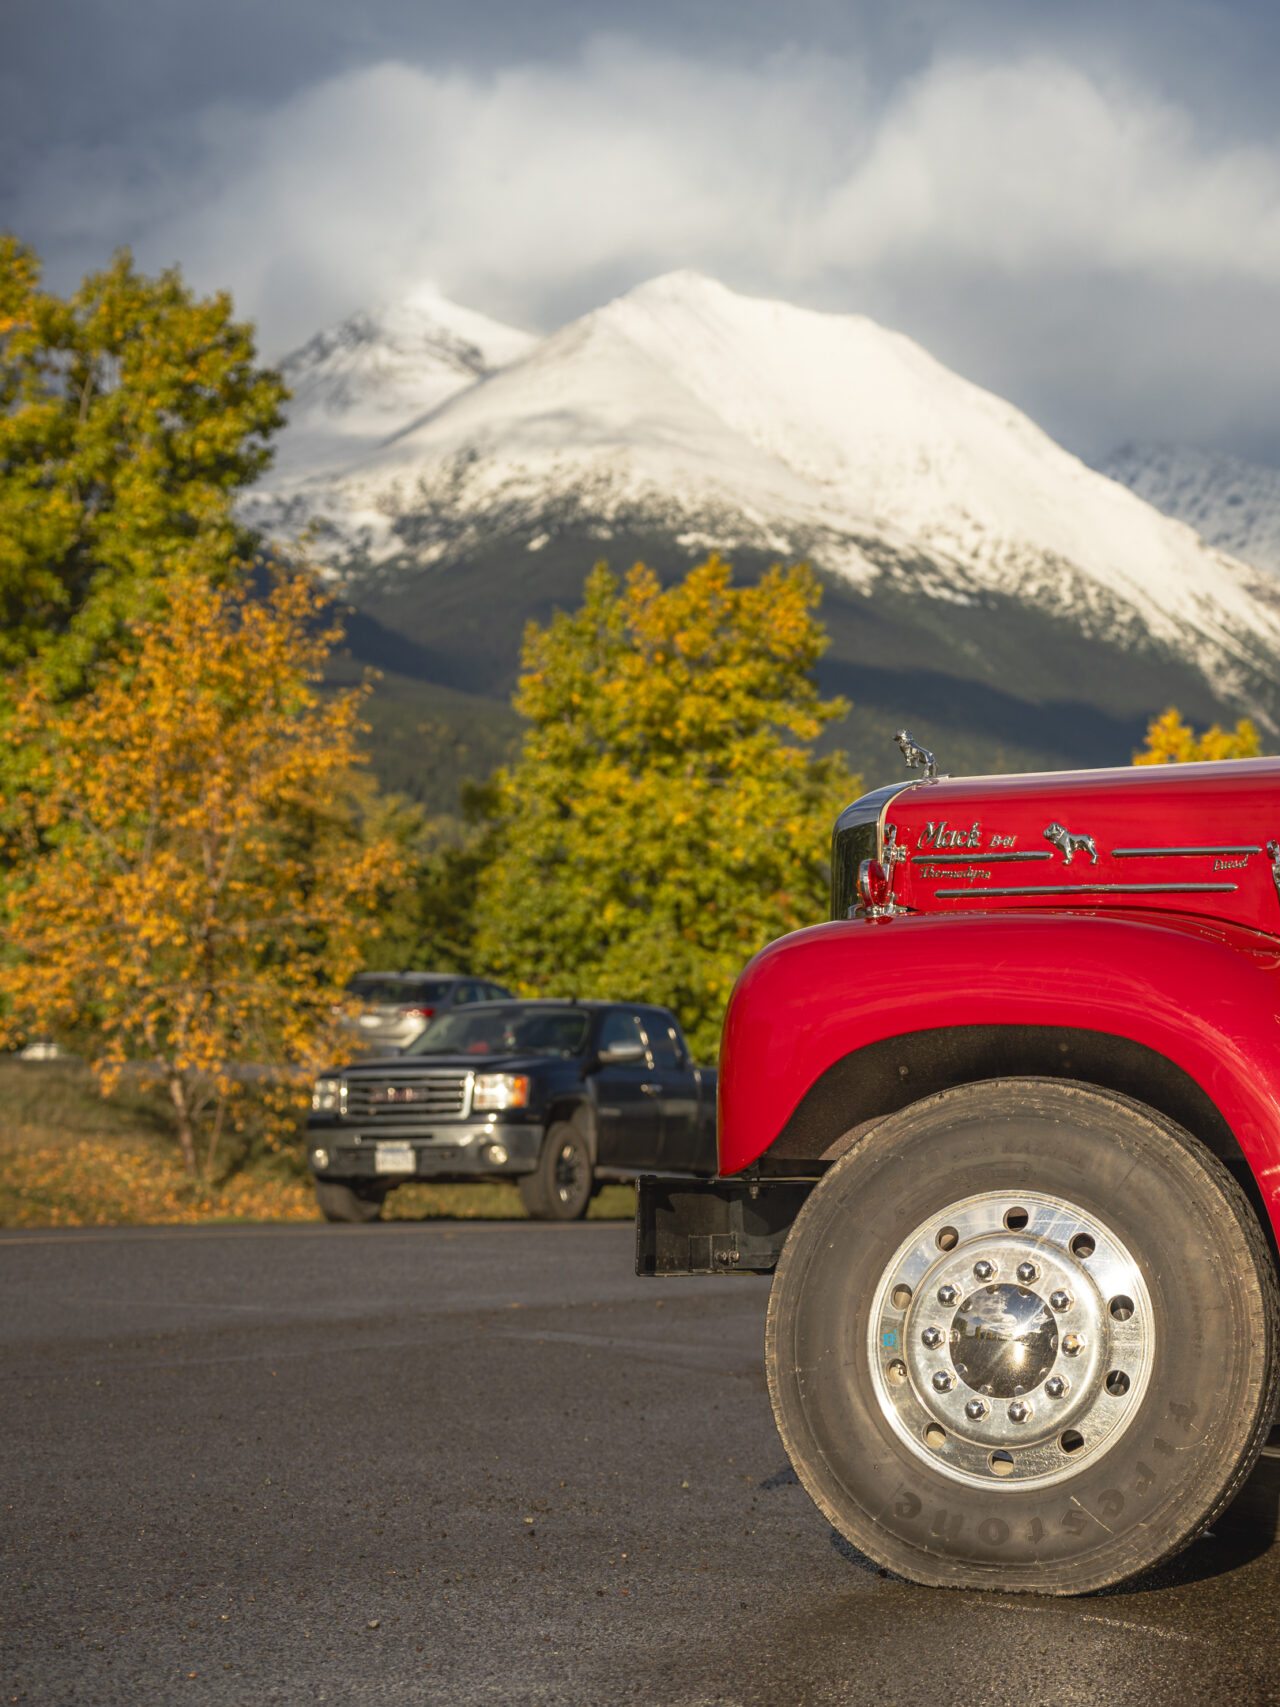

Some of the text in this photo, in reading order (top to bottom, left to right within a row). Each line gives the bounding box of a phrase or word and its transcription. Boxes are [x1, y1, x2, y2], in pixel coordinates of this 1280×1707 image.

[915, 821, 982, 849] Mack
[1212, 854, 1249, 872] Diesel
[919, 865, 991, 883] Thermodyne
